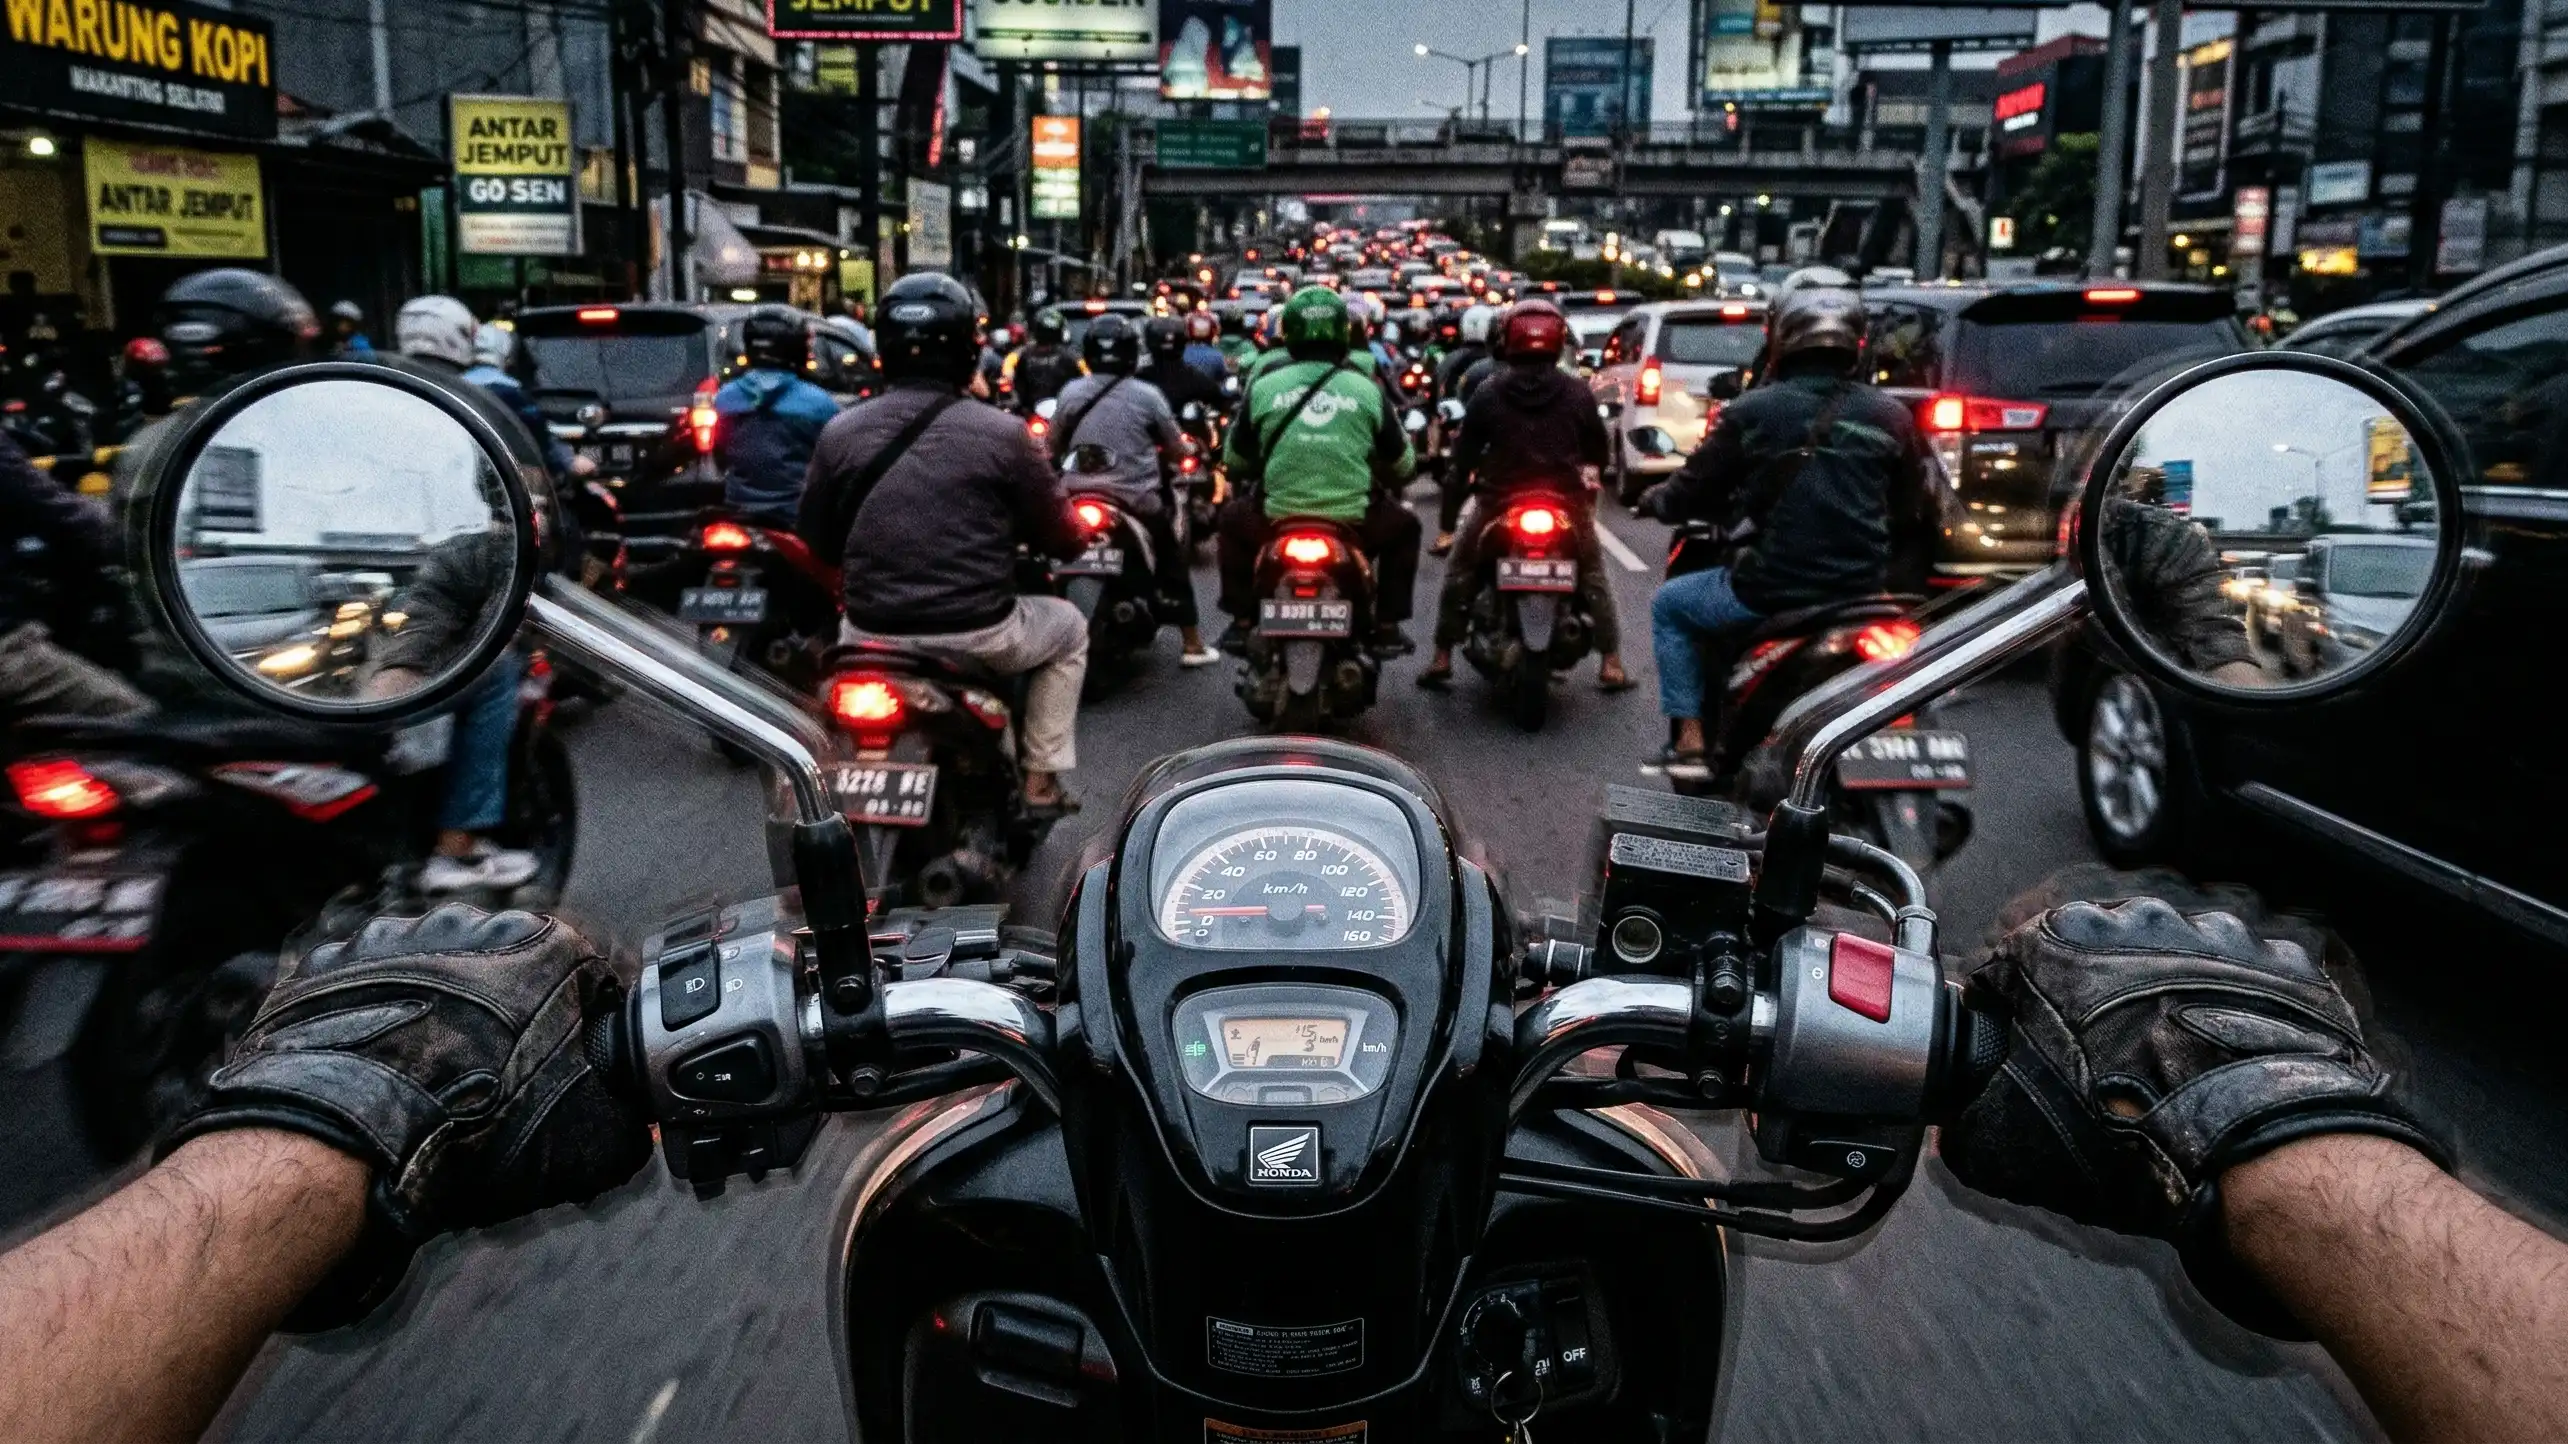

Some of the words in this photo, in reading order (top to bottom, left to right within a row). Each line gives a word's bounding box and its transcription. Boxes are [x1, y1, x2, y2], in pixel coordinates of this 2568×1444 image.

[4, 0, 183, 71] WARUNG
[189, 18, 270, 87] KOPI
[469, 116, 558, 139] ANTAR
[462, 143, 568, 166] JEMPUT
[469, 178, 506, 203] GO
[510, 178, 566, 203] SEN
[99, 183, 171, 215] ANTAR
[179, 188, 254, 222] JEMPUT
[1253, 850, 1278, 861] 60
[1293, 850, 1318, 861] 80
[1220, 865, 1246, 877] 40
[1320, 864, 1349, 876] 100
[1201, 889, 1226, 900] 20
[1262, 882, 1309, 895] km/h
[1339, 886, 1369, 898] 120
[1346, 909, 1375, 922] 140
[1342, 929, 1372, 941] 160
[1257, 1168, 1312, 1178] HONDA
[1563, 1347, 1586, 1362] OFF
